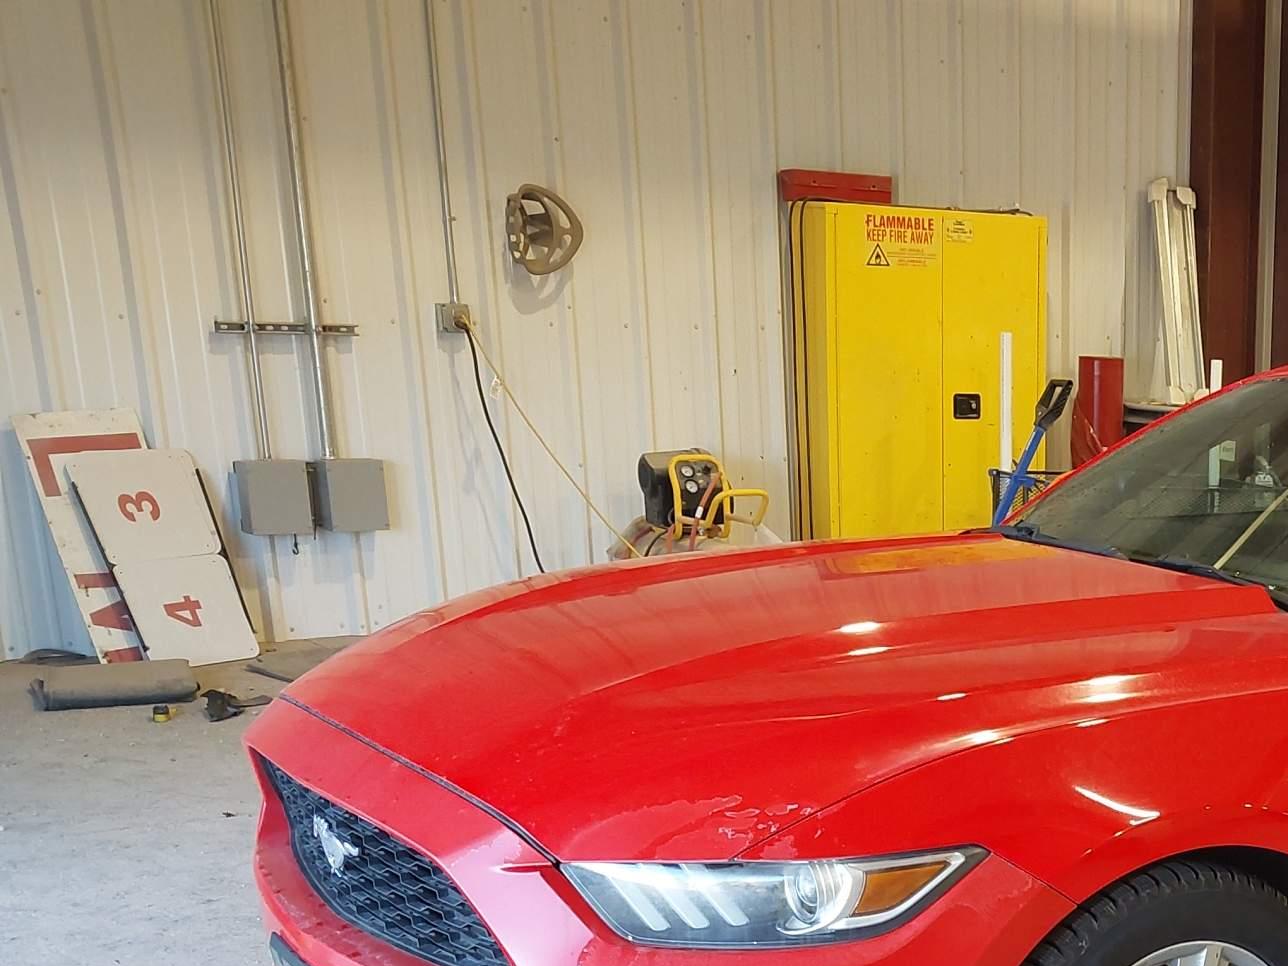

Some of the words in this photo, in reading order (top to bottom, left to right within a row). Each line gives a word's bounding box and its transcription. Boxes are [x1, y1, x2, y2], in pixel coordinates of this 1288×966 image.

[865, 214, 934, 231] FLAMMABLE
[866, 229, 887, 242] KEEP
[889, 230, 908, 243] FIRE
[910, 231, 934, 245] AWAY
[117, 490, 161, 522] 3
[163, 595, 203, 627] 4
